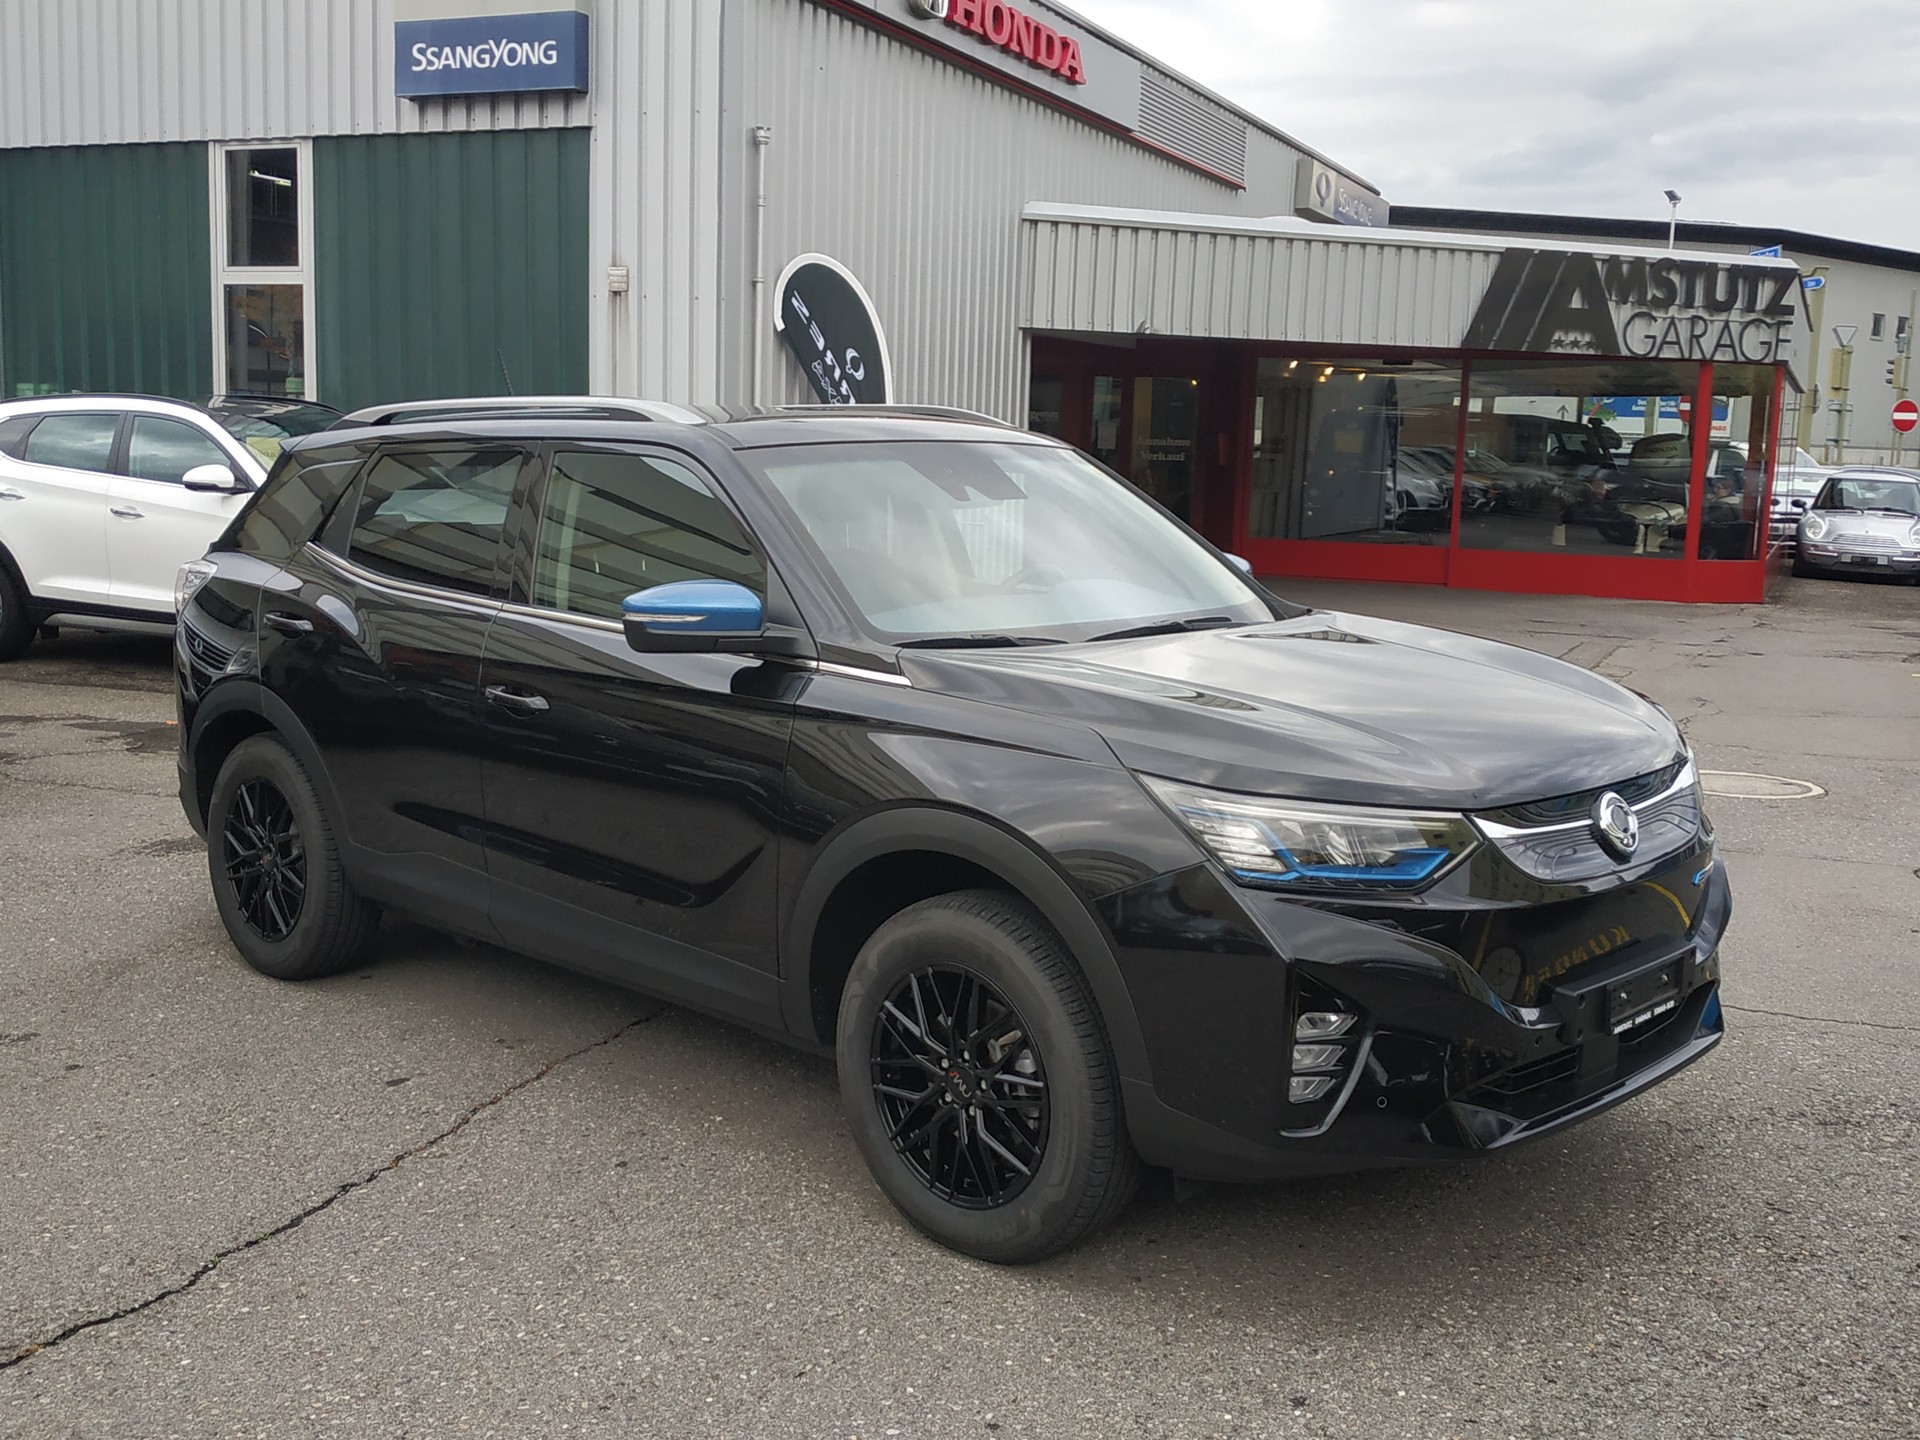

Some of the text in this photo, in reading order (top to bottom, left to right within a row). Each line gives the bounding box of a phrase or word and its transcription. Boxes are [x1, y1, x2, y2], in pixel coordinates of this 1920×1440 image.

[948, 0, 1086, 85] HONDA
[1545, 250, 1800, 356] AMSTUTZ
[1622, 310, 1794, 364] GARAGE
[1140, 451, 1186, 461] Verkauf
